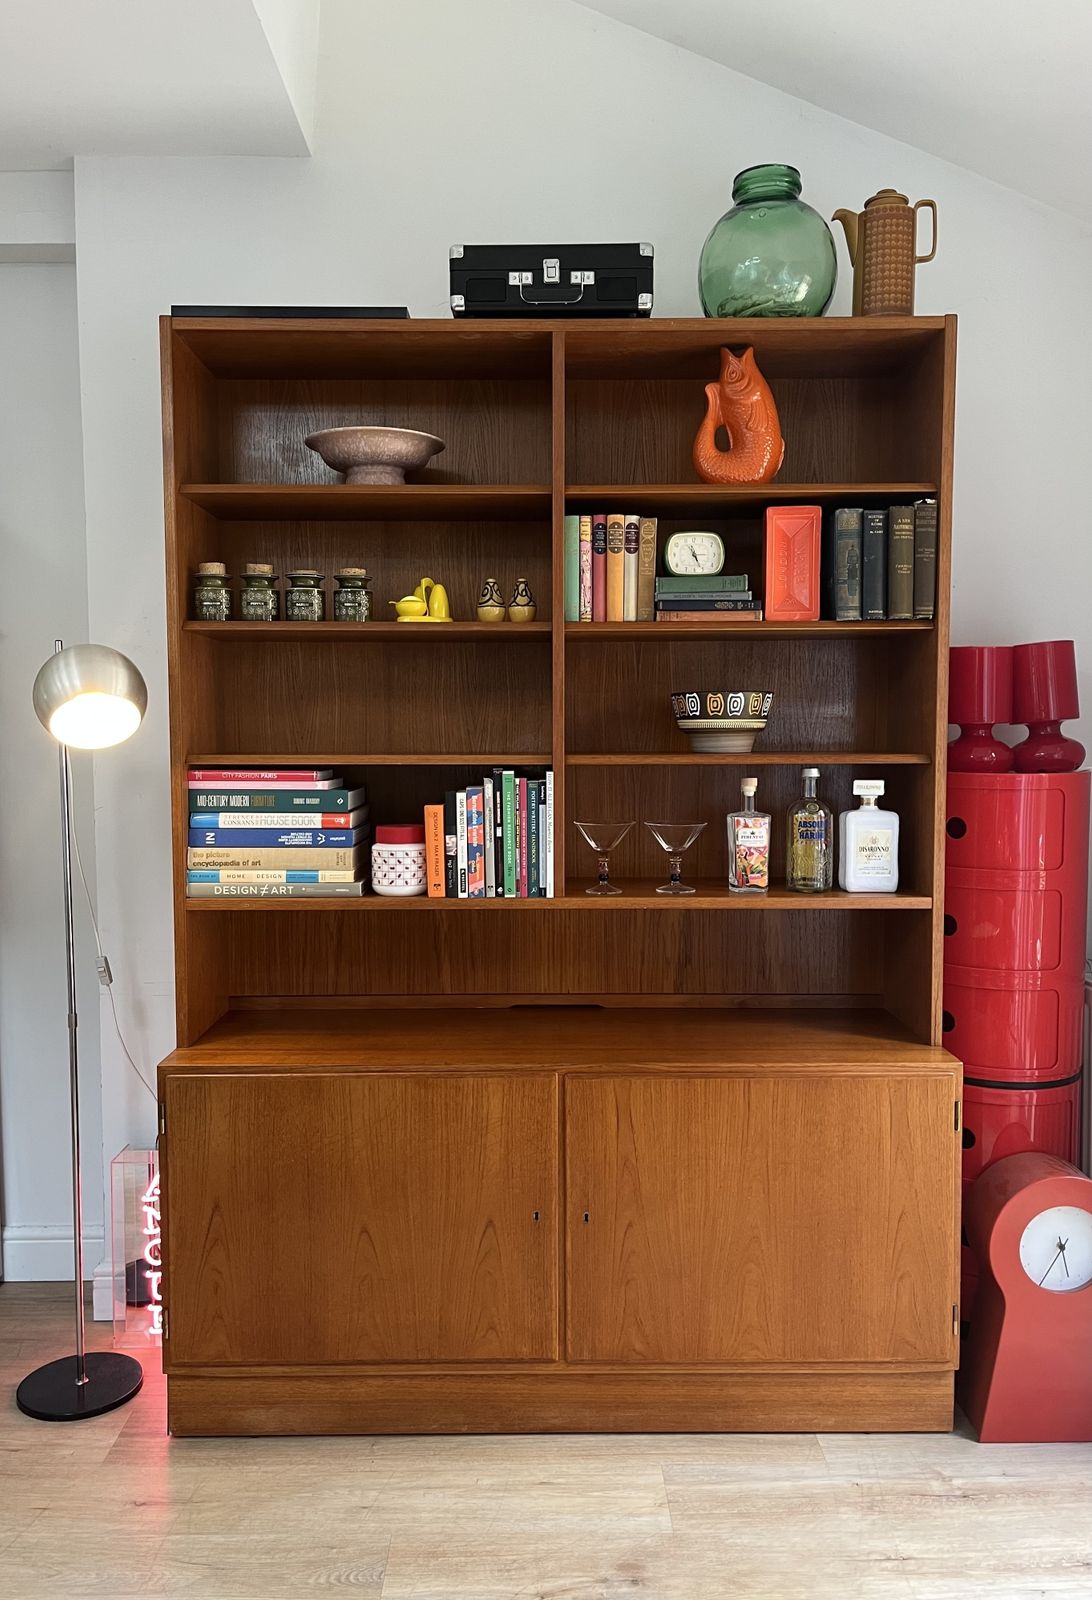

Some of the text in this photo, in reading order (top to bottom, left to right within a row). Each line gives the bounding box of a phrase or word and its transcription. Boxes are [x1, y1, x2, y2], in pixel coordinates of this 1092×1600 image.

[197, 794, 229, 807] MID-CENTURY
[230, 794, 250, 807] MODERN
[261, 816, 290, 826] HOUSE
[292, 816, 316, 826] BOOK
[214, 886, 257, 894] DESIGN
[271, 886, 294, 894] ART
